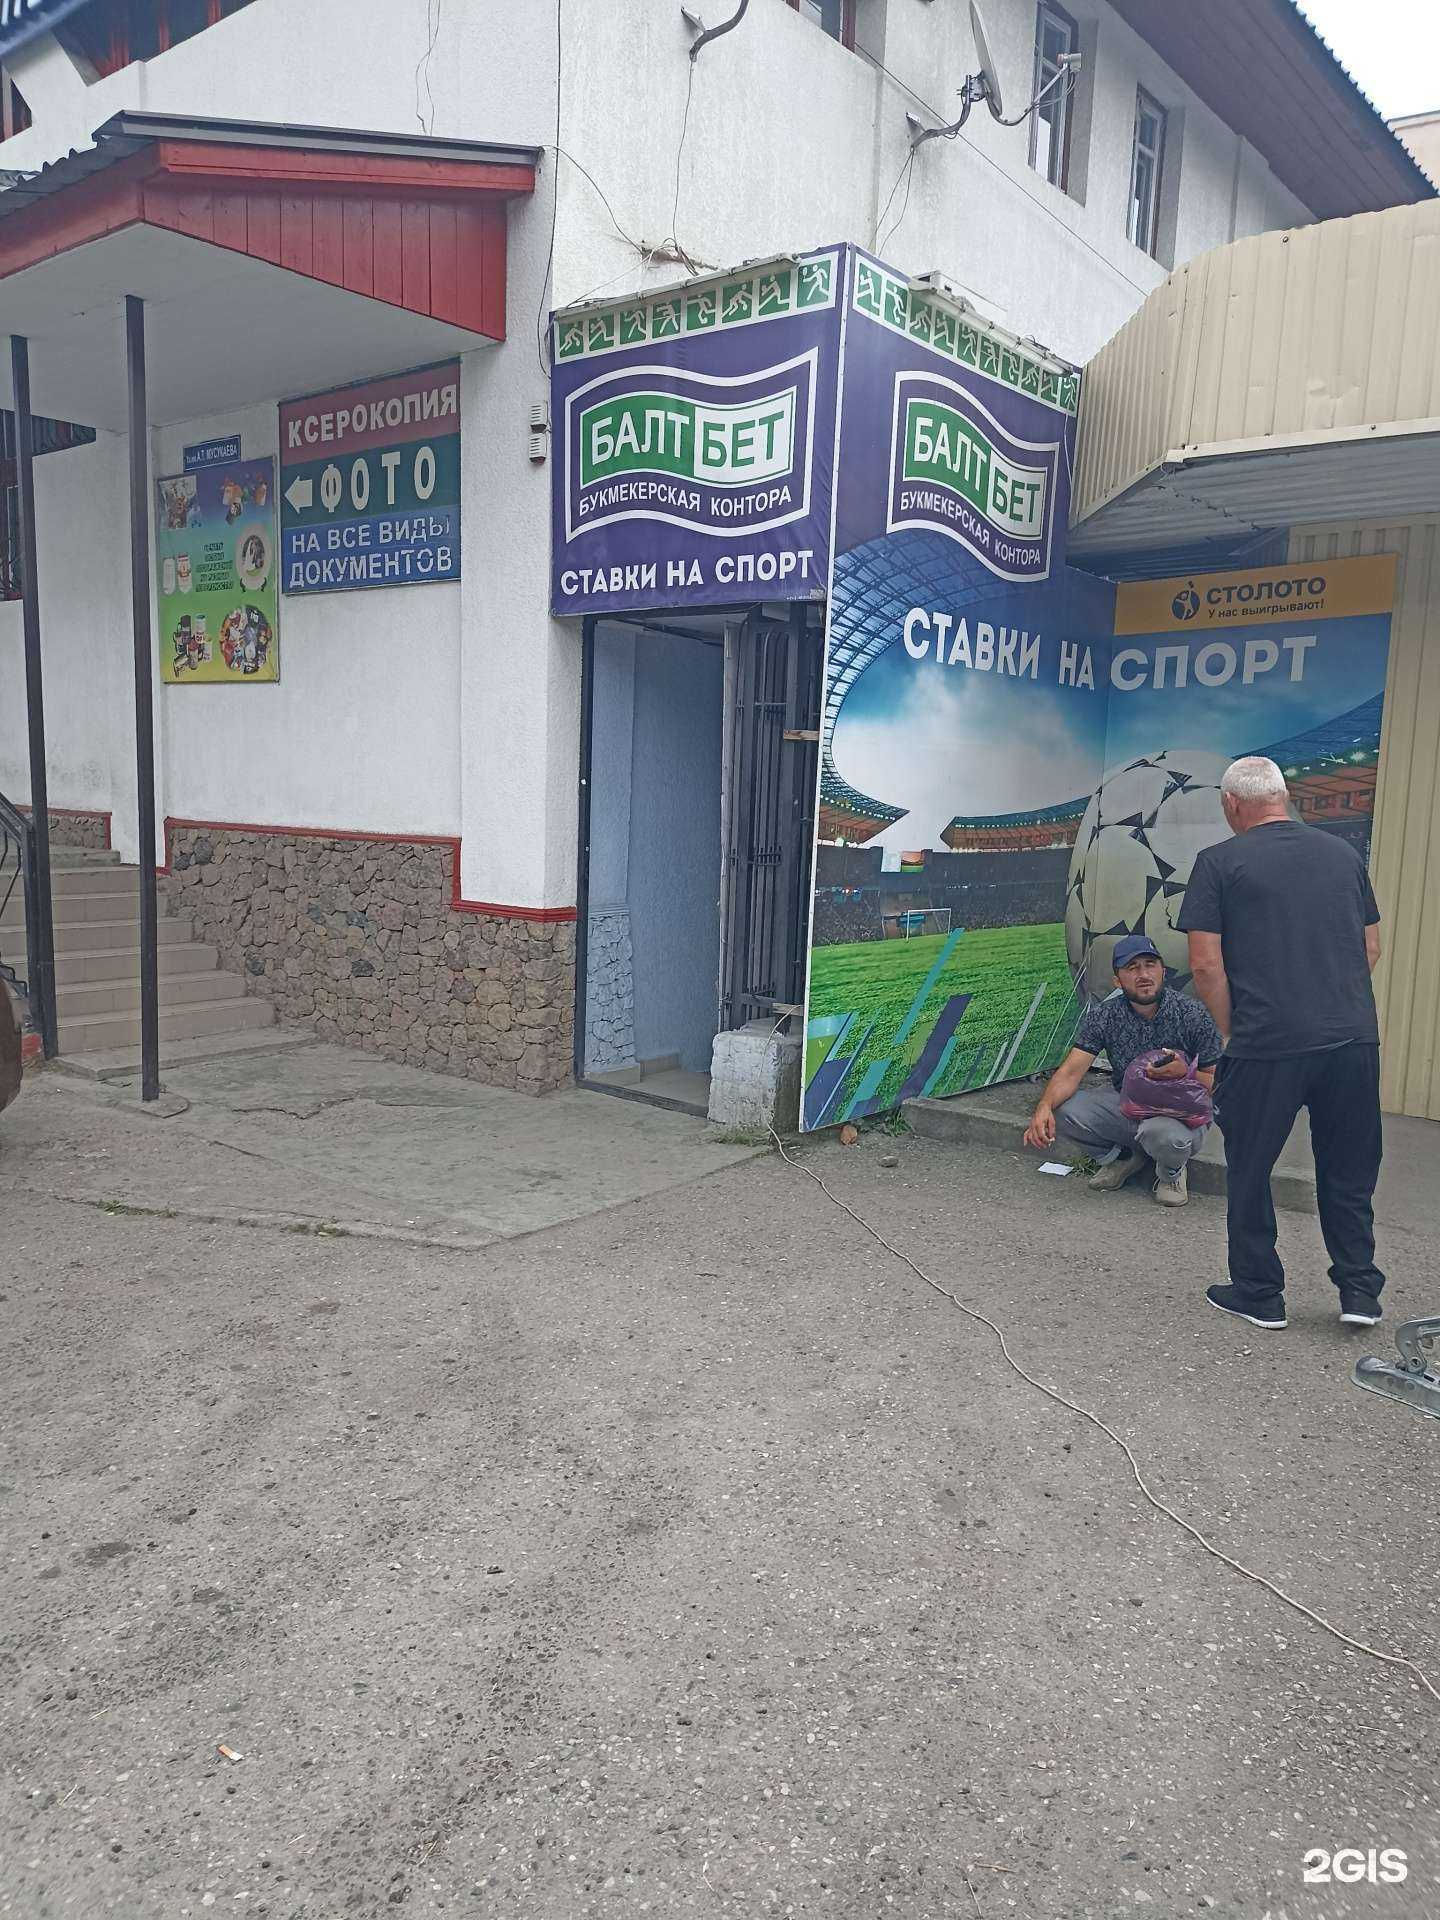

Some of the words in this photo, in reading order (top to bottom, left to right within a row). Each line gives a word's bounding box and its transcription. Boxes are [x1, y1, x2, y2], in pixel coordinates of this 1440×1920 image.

[288, 384, 457, 448] КСЕРОКОПИЯ
[592, 410, 690, 466] БАЛТ
[702, 410, 785, 468] БЕТ
[320, 446, 436, 513] ФОТО
[913, 417, 988, 492] БАЛТ
[992, 470, 1041, 524] БЕТ
[579, 482, 701, 516] БУКМЕКЕРСКАЯ
[711, 485, 791, 516] КОНТОРА
[292, 533, 320, 554] НА
[327, 525, 371, 550] ВСЕ
[379, 515, 450, 544] ВИДЫ
[900, 491, 990, 546] БУКМЕКЕРСКАЯ
[994, 534, 1041, 565] КОНТОРА
[289, 546, 452, 588] ДОКУМЕНТОВ
[560, 563, 657, 595] СТАВКИ
[667, 559, 704, 587] НА
[715, 550, 814, 582] СПОРТ
[1206, 576, 1326, 605] СТОЛОТО
[1218, 609, 1238, 618] нас
[1242, 598, 1325, 616] выигрывают!
[903, 607, 1041, 679] СТАВКИ
[1059, 640, 1094, 690] НА
[1110, 635, 1317, 690] СПОРТ
